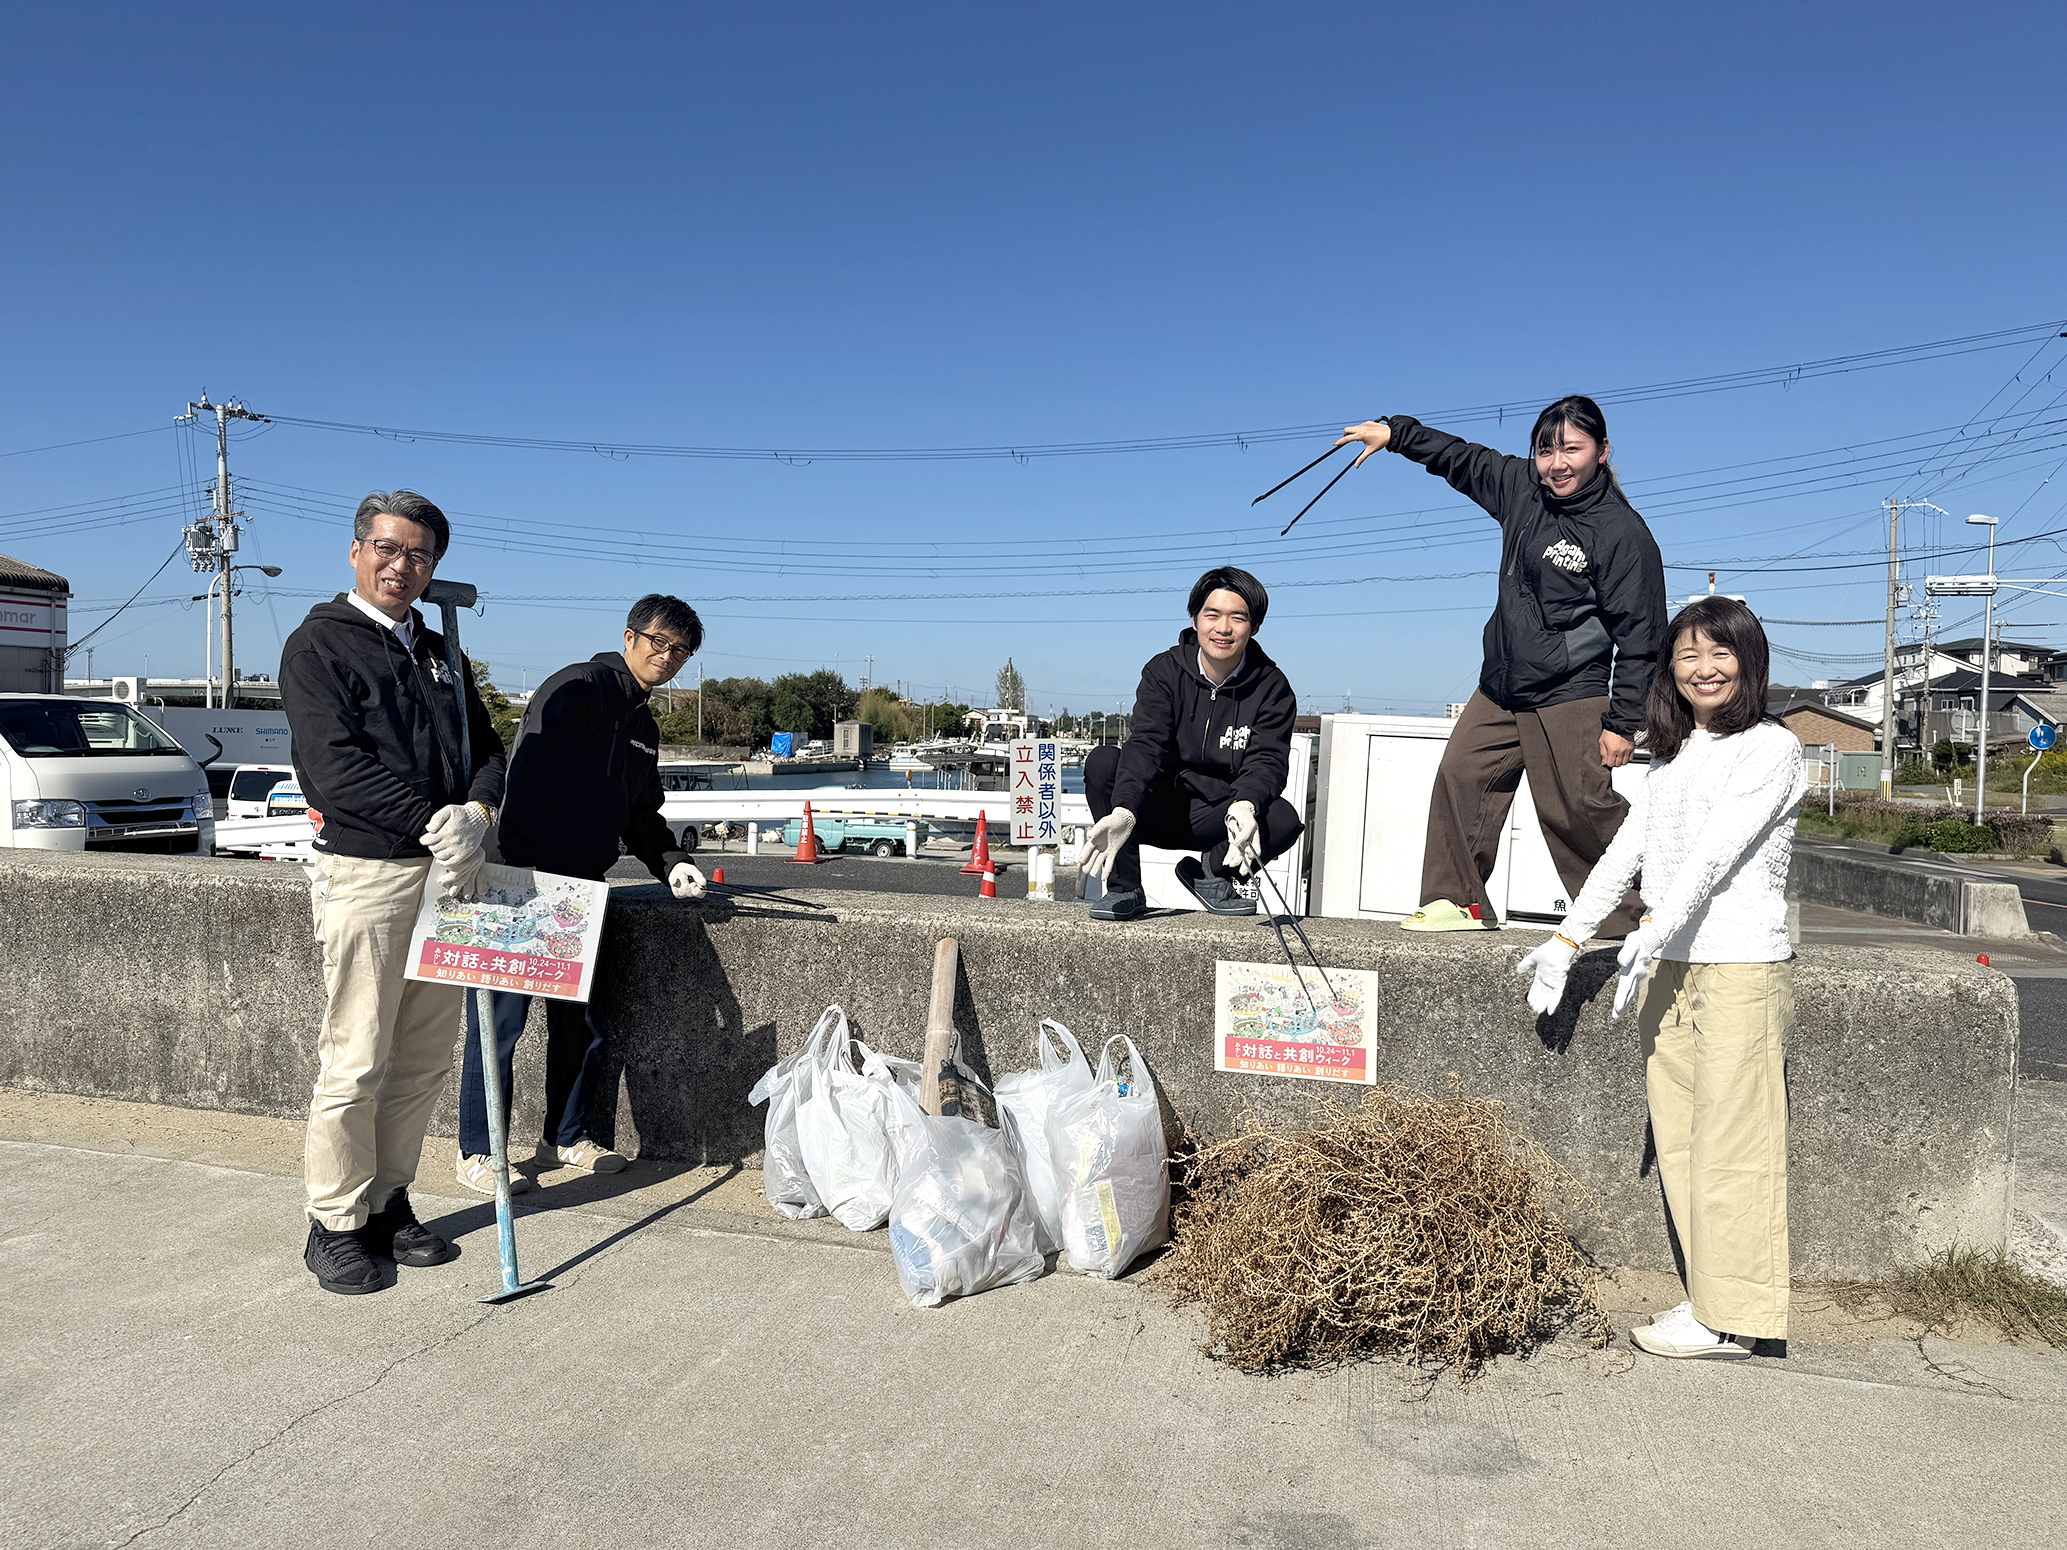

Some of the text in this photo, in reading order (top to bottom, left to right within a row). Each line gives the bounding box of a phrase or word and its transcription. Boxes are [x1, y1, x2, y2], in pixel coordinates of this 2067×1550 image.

[0, 610, 36, 624] mar
[1016, 745, 1034, 839] 立入禁止
[1038, 743, 1056, 839] 関係者以外
[1554, 899, 1566, 912] 魚
[436, 968, 561, 993] 知りあい 語りあい 創りだす
[1240, 1060, 1349, 1078] 知りあい 語りあい 創りだす
